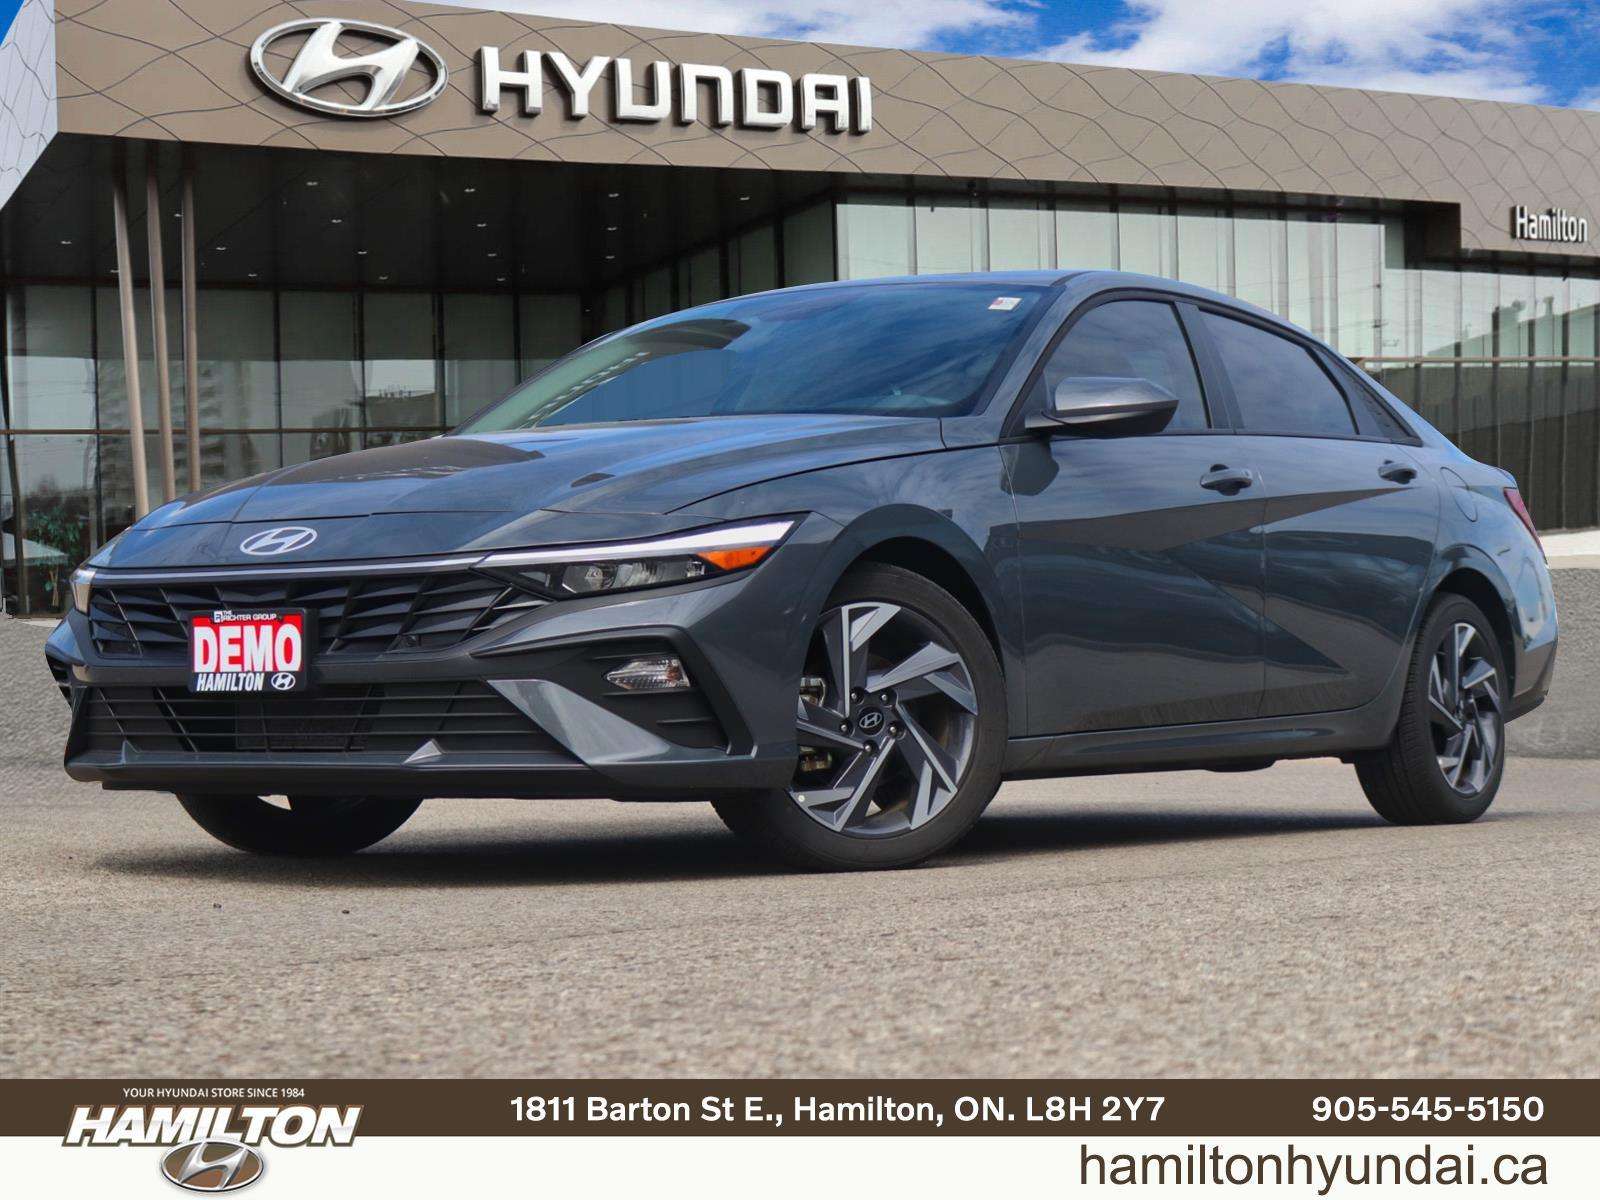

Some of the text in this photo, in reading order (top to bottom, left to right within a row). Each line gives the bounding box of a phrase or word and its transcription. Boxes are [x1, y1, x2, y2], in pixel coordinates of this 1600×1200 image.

[480, 46, 872, 133] HYUNDAI
[1515, 205, 1588, 242] Hamilton
[252, 613, 277, 621] GROUP
[194, 623, 302, 672] DEMO
[196, 672, 265, 692] HAMILTON
